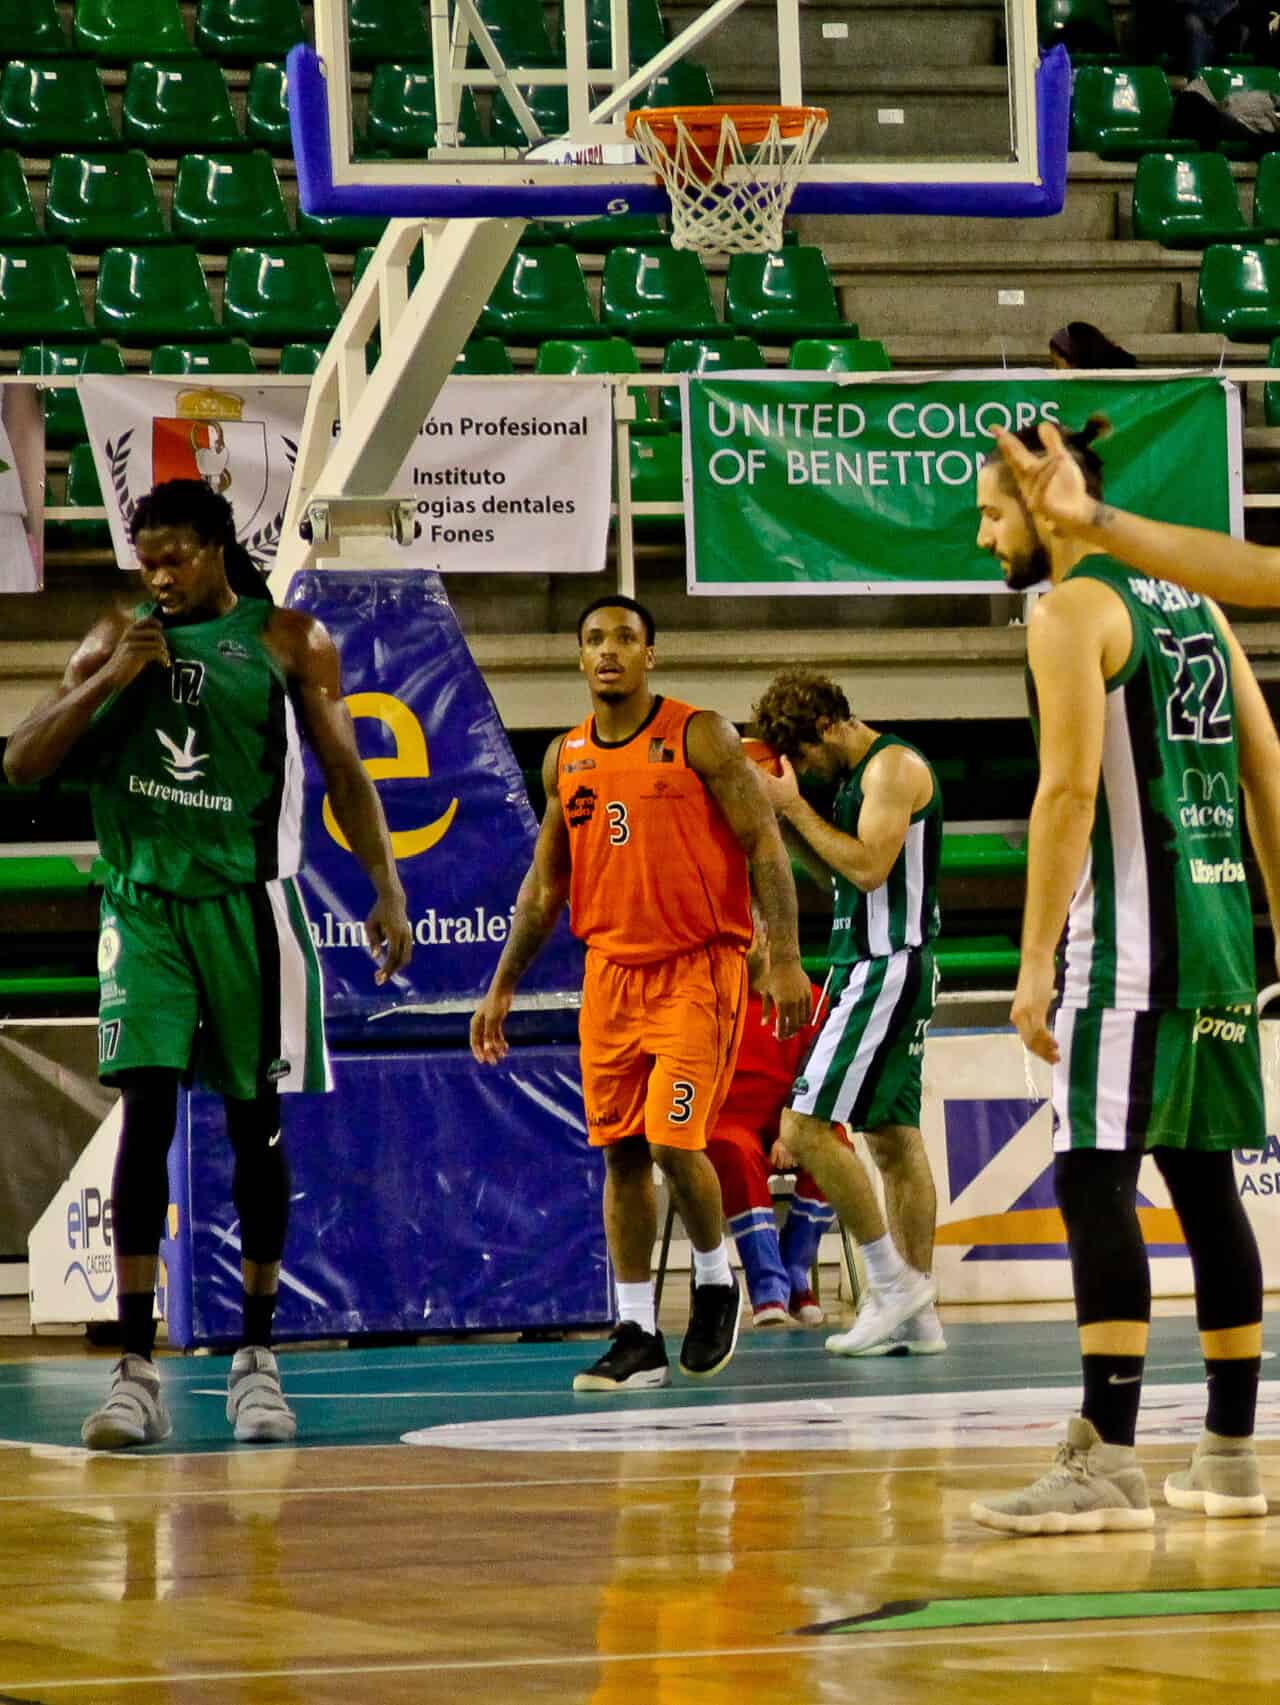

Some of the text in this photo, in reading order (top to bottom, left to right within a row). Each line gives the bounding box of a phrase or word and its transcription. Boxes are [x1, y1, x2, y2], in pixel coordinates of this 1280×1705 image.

[460, 416, 588, 436] Profesional
[707, 401, 865, 439] UNITED
[412, 466, 507, 486] Instituto
[708, 448, 767, 486] OF
[416, 495, 576, 518] ogias dentales
[430, 524, 495, 543] Fones
[1152, 627, 1233, 745] 22
[128, 774, 233, 812] Extremadura
[605, 800, 631, 846] 3
[667, 1080, 696, 1124] 3
